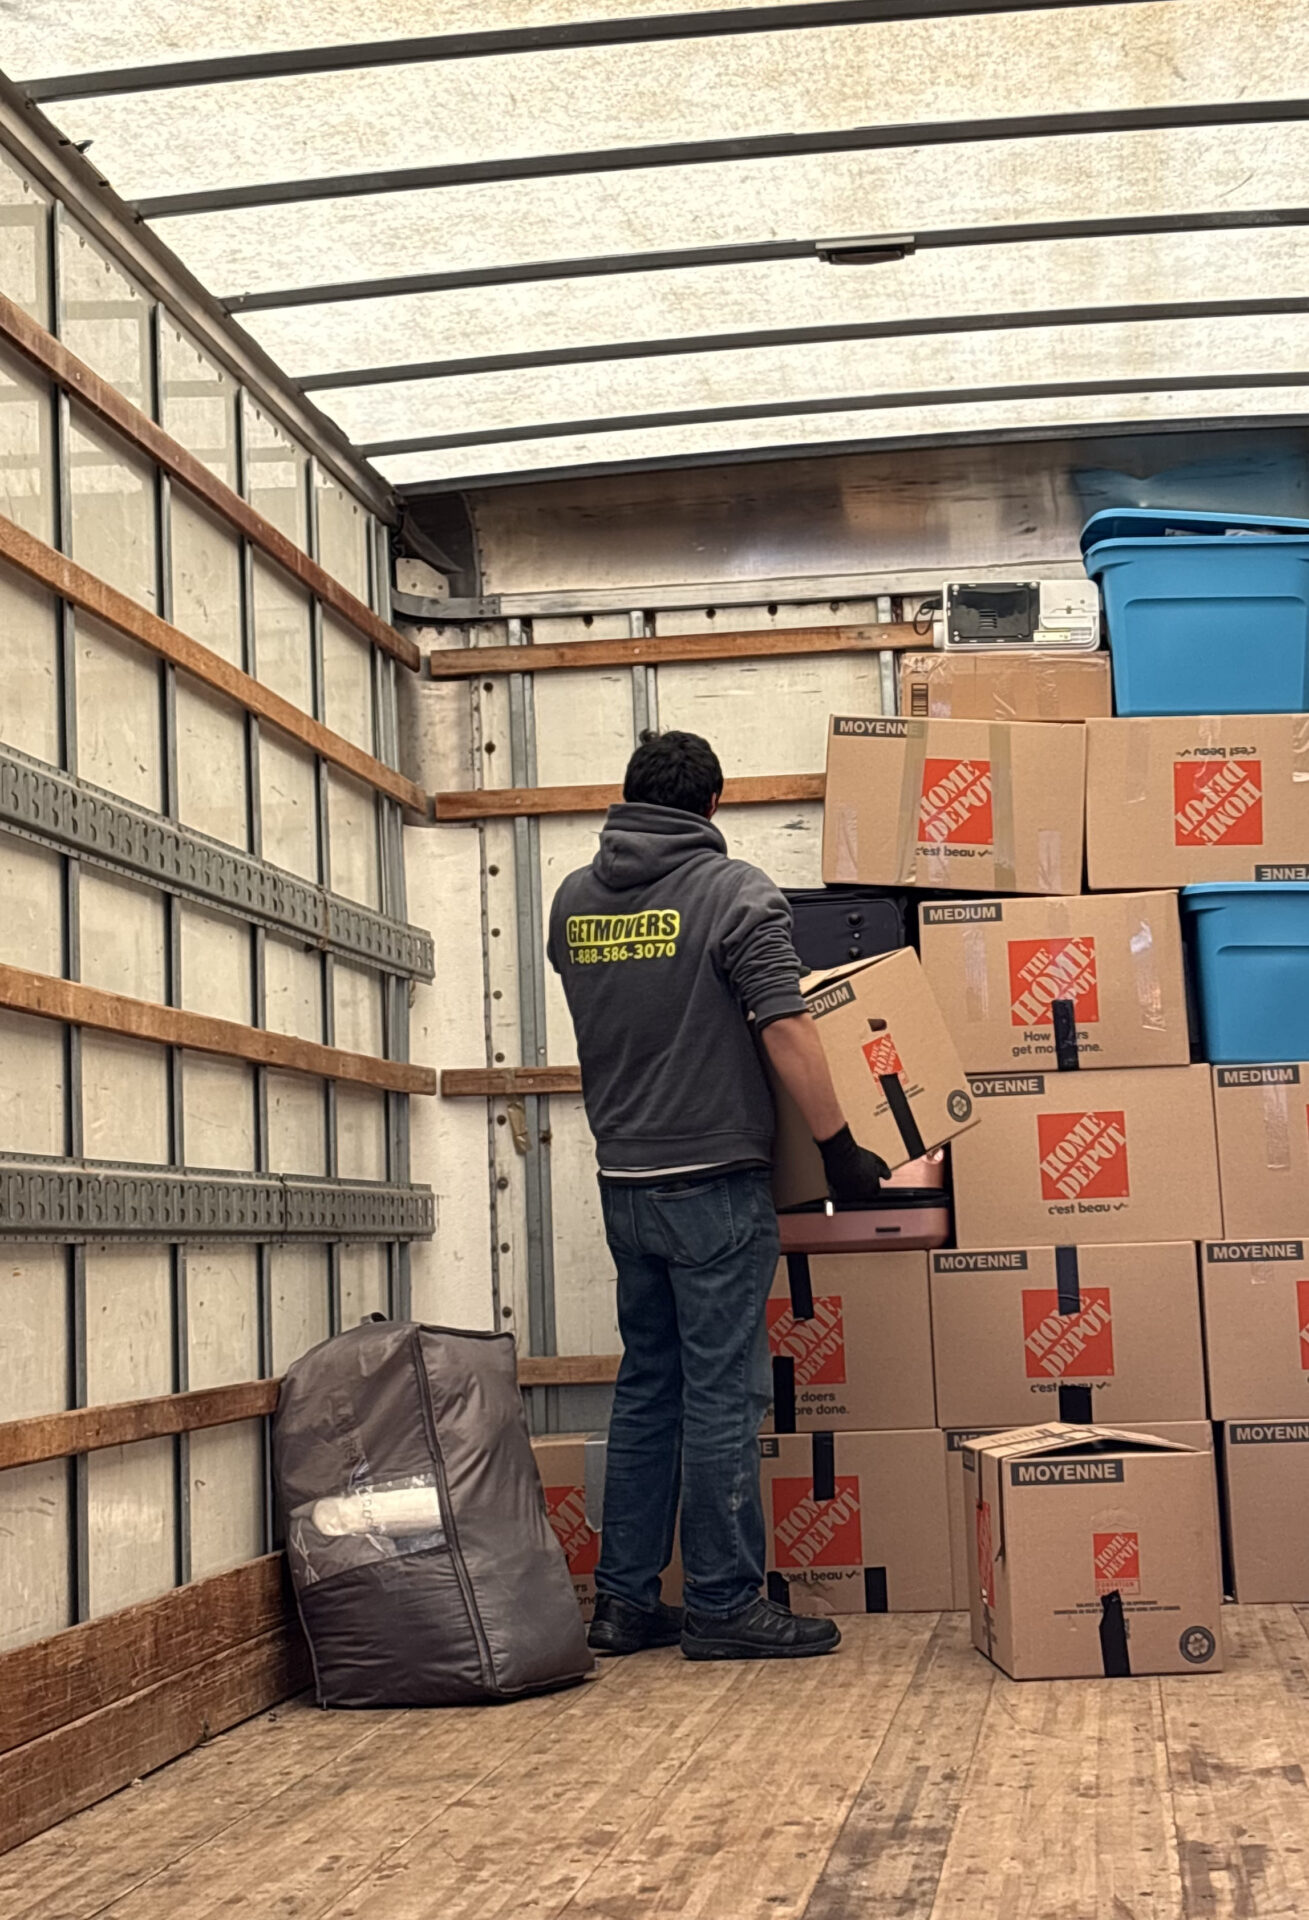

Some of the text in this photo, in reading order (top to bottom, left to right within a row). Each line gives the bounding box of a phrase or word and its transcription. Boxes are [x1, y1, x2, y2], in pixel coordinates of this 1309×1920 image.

[1193, 746, 1257, 758] c'est beau
[919, 759, 981, 824] HOME
[1174, 760, 1262, 846] HOME DEPOT
[943, 846, 976, 858] beau
[929, 906, 996, 921] MEDIUM
[568, 912, 677, 943] GETMOVERS
[569, 942, 676, 965] 1-888-586-3070
[1017, 948, 1054, 982] THE
[1011, 937, 1096, 1026] HOME
[808, 986, 850, 1015] EDIUM
[1023, 1031, 1051, 1042] How
[1012, 1045, 1032, 1057] get
[1076, 1042, 1104, 1053] one.
[1223, 1068, 1294, 1084] MEDIUM
[972, 1079, 1039, 1094] OYENNE
[1040, 1111, 1127, 1199] HOME DEPOT
[1048, 1202, 1111, 1215] c'est beau
[1213, 1244, 1297, 1260] MOYENNE
[940, 1254, 1022, 1270] MOYENNE
[778, 1297, 844, 1363] OME
[1040, 1299, 1112, 1378] DEPOT
[794, 1328, 845, 1385] DEPOT
[1030, 1382, 1057, 1393] c'est
[800, 1392, 836, 1402] doers
[816, 1404, 851, 1415] done.
[1018, 1463, 1117, 1482] MOYENNE
[789, 1487, 861, 1567] DEPOT
[1094, 1532, 1140, 1579] HOME DEPOT
[810, 1570, 843, 1580] beau
